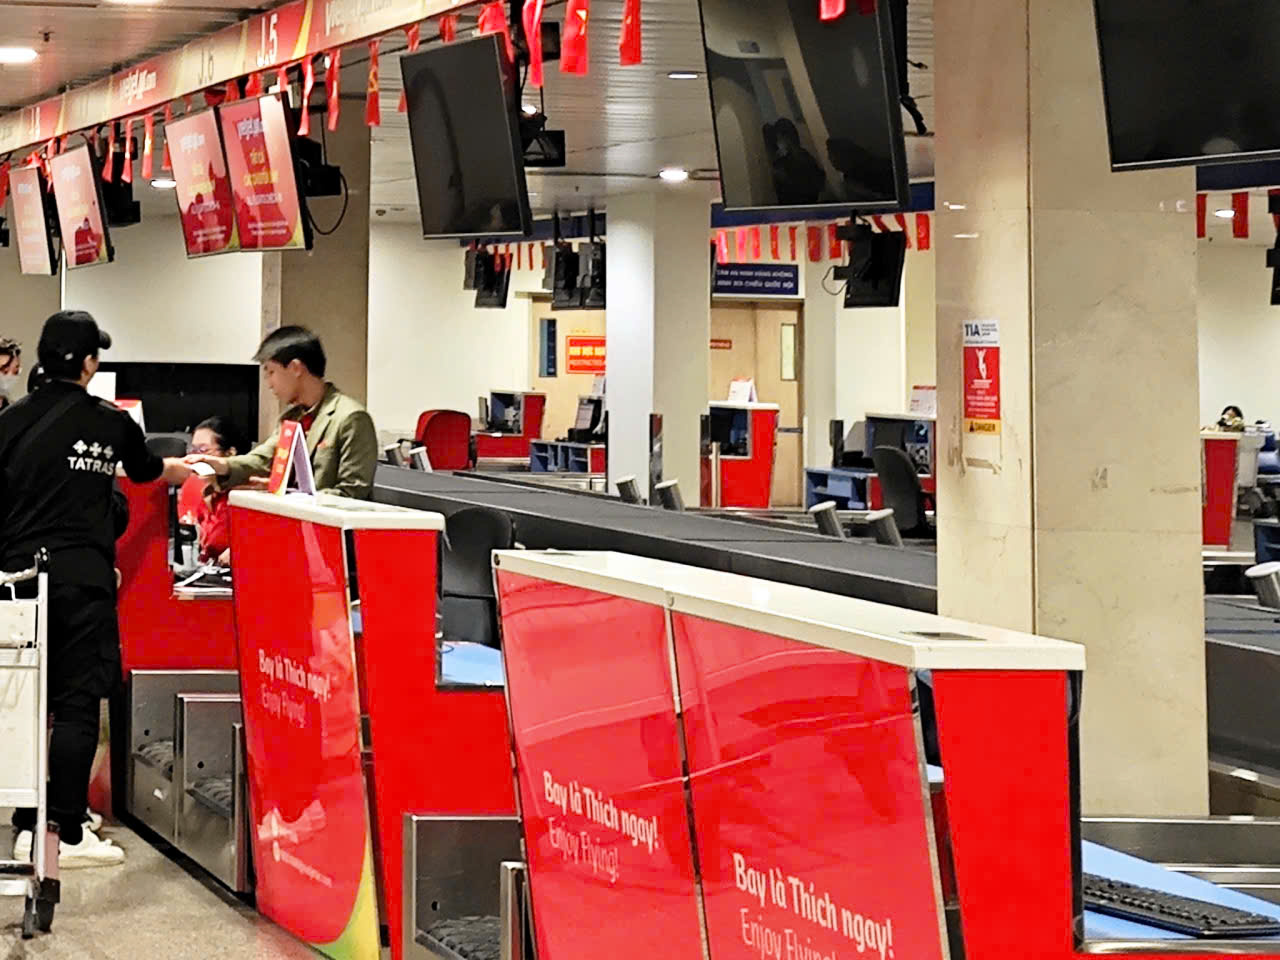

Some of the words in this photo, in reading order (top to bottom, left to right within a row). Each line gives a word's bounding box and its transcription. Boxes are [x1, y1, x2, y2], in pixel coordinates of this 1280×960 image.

[256, 13, 279, 67] J.5
[67, 456, 114, 476] TATRAS
[543, 770, 568, 816] Bay
[569, 780, 583, 815] là
[582, 787, 619, 831] Thích
[621, 809, 660, 854] ngay!
[548, 817, 579, 865] Enjoy
[580, 831, 620, 883] Flying!
[732, 852, 766, 907] Bay
[769, 867, 787, 909] là
[787, 875, 838, 932] Thích
[841, 907, 895, 960] ngay!
[740, 908, 782, 960] Enjoy
